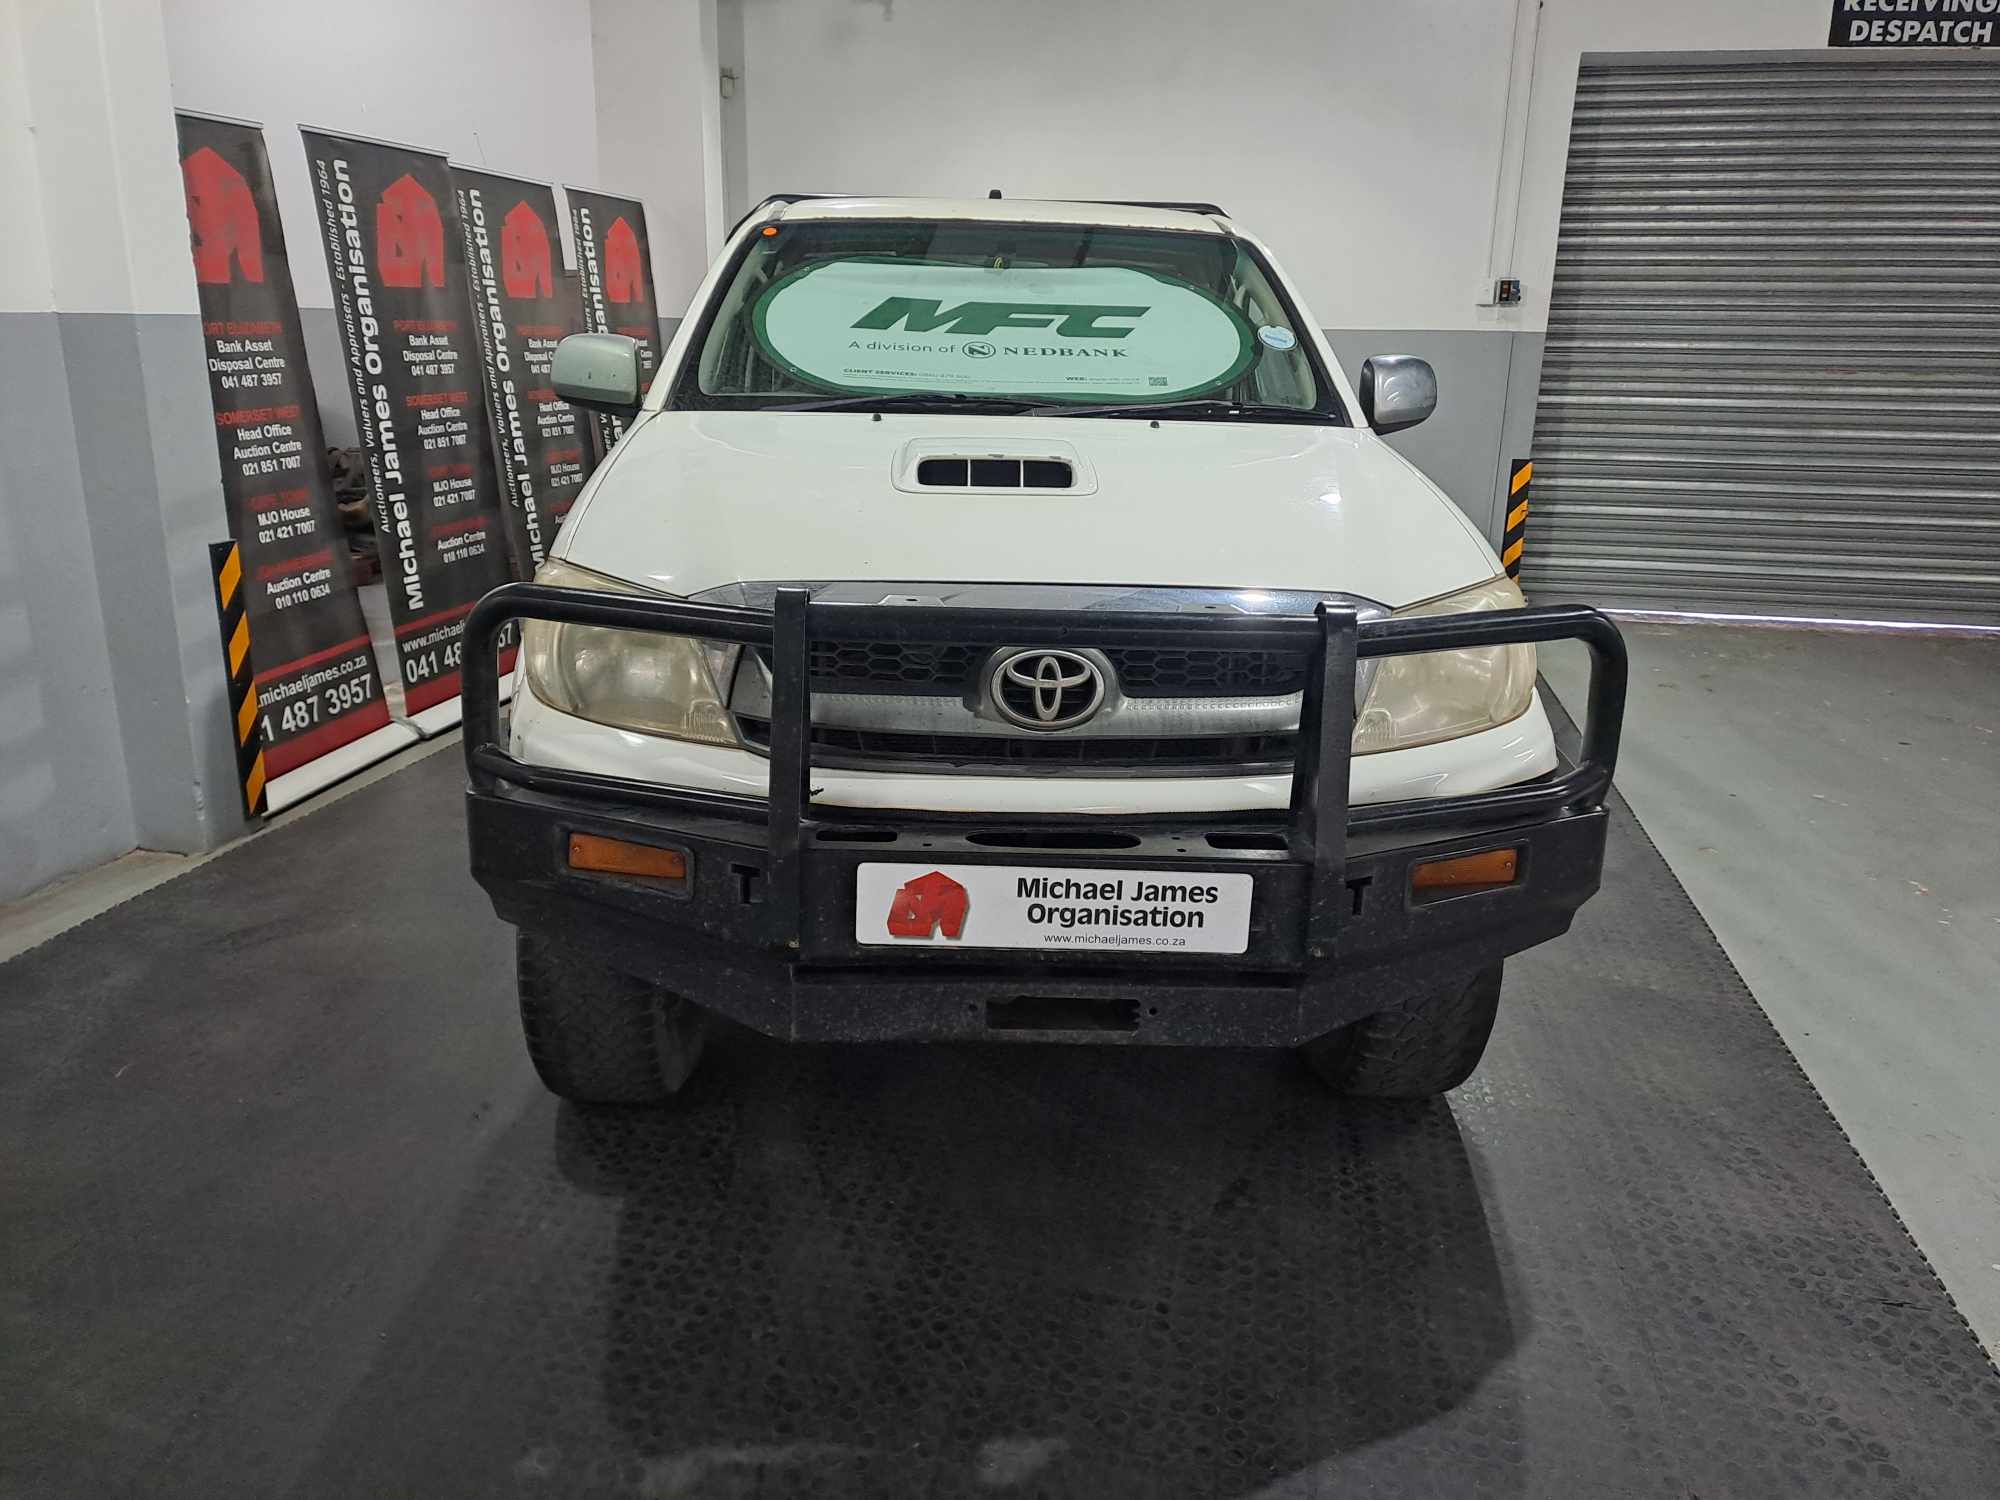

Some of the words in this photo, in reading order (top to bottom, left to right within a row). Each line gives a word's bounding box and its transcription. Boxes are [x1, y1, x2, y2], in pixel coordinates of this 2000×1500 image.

[1843, 0, 2000, 13] RECEIVING
[1849, 19, 1993, 43] DESPATCH
[316, 159, 331, 194] 1964
[322, 198, 346, 281] Established
[333, 159, 383, 375] Organisation
[469, 189, 510, 372] Organisation
[341, 292, 361, 366] Appraisers
[849, 296, 1152, 339] MFC
[216, 339, 244, 353] Bank
[244, 339, 273, 352] Asset
[408, 334, 429, 346] Bank
[429, 334, 449, 346] Asset
[849, 340, 861, 350] A
[866, 340, 933, 353] division
[936, 343, 957, 353] of
[1003, 346, 1129, 358] NEDBANK
[208, 356, 253, 373] Disposal
[254, 356, 286, 369] Centre
[402, 350, 436, 363] Disposal
[221, 375, 239, 389] 041
[241, 374, 258, 388] 487
[260, 372, 282, 387] 3957
[353, 370, 367, 395] and
[360, 398, 375, 448] Valuers
[420, 408, 440, 420] Head
[502, 379, 528, 466] James
[236, 426, 263, 441] Head
[263, 424, 292, 438] Office
[372, 384, 403, 485] James
[418, 424, 446, 436] Auction
[233, 444, 271, 460] Auction
[272, 440, 302, 454] Centre
[242, 462, 260, 476] 021
[260, 459, 279, 473] 851
[279, 455, 301, 470] 7007
[257, 510, 279, 526] MJO
[280, 507, 311, 522] House
[517, 472, 546, 573] Michael
[258, 529, 276, 544] 021
[277, 525, 294, 539] 421
[388, 493, 424, 611] Michael
[266, 576, 302, 595] Auction
[302, 567, 332, 585] Centre
[275, 594, 292, 610] 010
[292, 589, 309, 604] 110
[402, 619, 465, 653] www.michael
[405, 650, 439, 684] 041
[444, 641, 462, 668] 48
[258, 655, 368, 708] .michaeljames.co.za
[281, 695, 319, 732] 487
[325, 673, 372, 715] 3957
[1016, 877, 1124, 901] Michael
[1130, 881, 1219, 904] James
[1027, 903, 1205, 929] Organisation
[1044, 932, 1187, 947] www.michaeljames.co.za
